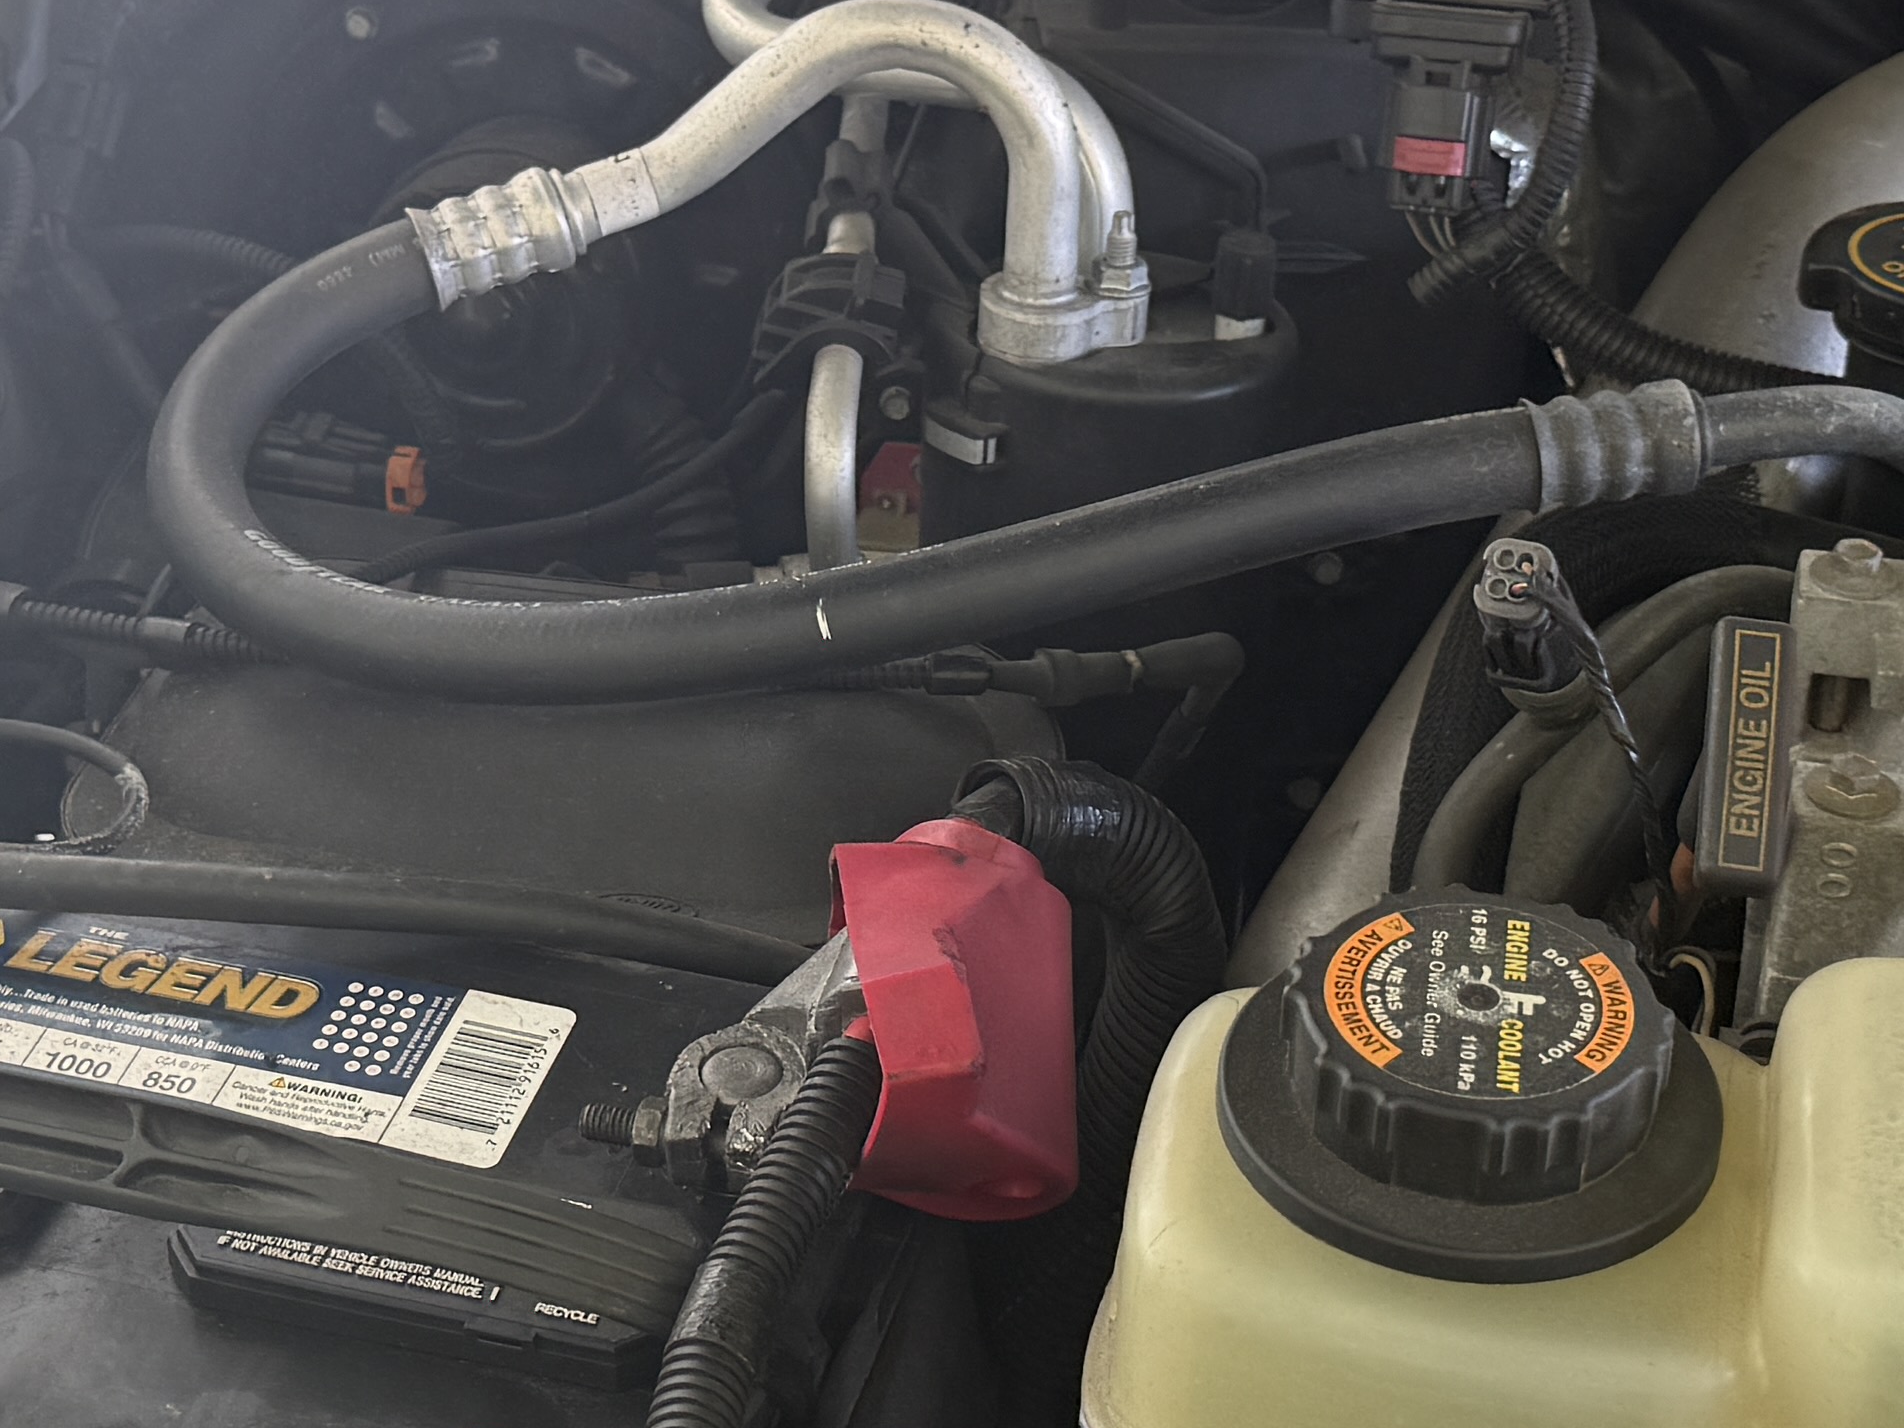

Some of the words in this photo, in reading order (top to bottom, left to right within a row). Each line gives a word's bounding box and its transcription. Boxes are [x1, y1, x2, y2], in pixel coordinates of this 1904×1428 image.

[1738, 660, 1774, 710] OIL
[1727, 716, 1766, 838] ENGINE
[1471, 909, 1488, 924] 16
[89, 927, 130, 940] THE
[1431, 930, 1449, 956] See
[1469, 927, 1487, 950] PSI
[1367, 939, 1412, 980] OUVRIR
[1504, 920, 1530, 982] ENGINE
[1542, 948, 1569, 967] DO
[3, 928, 322, 1020] LEGEND
[1386, 966, 1407, 986] NE
[1426, 961, 1446, 1008] Owner
[1566, 969, 1594, 998] NOT
[1334, 929, 1390, 1054] AVERTISSEMENT
[1385, 986, 1403, 1011] PAS
[57, 994, 68, 1006] in
[71, 997, 99, 1015] used
[99, 1000, 152, 1024] batteries
[153, 1013, 165, 1026] to
[1366, 995, 1403, 1040] CHAUD
[1570, 1003, 1595, 1041] OPEN
[1585, 980, 1627, 1062] WARNING
[151, 1029, 168, 1042] for
[173, 1033, 204, 1049] NAPA
[275, 1053, 320, 1071] Centers
[1421, 1013, 1441, 1057] Guide
[1460, 1035, 1477, 1060] 110
[44, 1051, 113, 1079] 1000
[1496, 1018, 1524, 1094] COOLANT
[1538, 1040, 1576, 1065] HOT
[142, 1071, 197, 1095] 850
[496, 1087, 526, 1125] 21112
[518, 1048, 548, 1084] 91615
[1457, 1063, 1475, 1090] kPa
[217, 1235, 231, 1246] IF
[230, 1238, 258, 1253] NOT
[258, 1244, 322, 1267] AVAILABLE
[322, 1257, 354, 1273] SEEK
[356, 1264, 406, 1284] SERVICE
[330, 1247, 379, 1267] VEHICLE
[534, 1301, 599, 1326] RECYCLE
